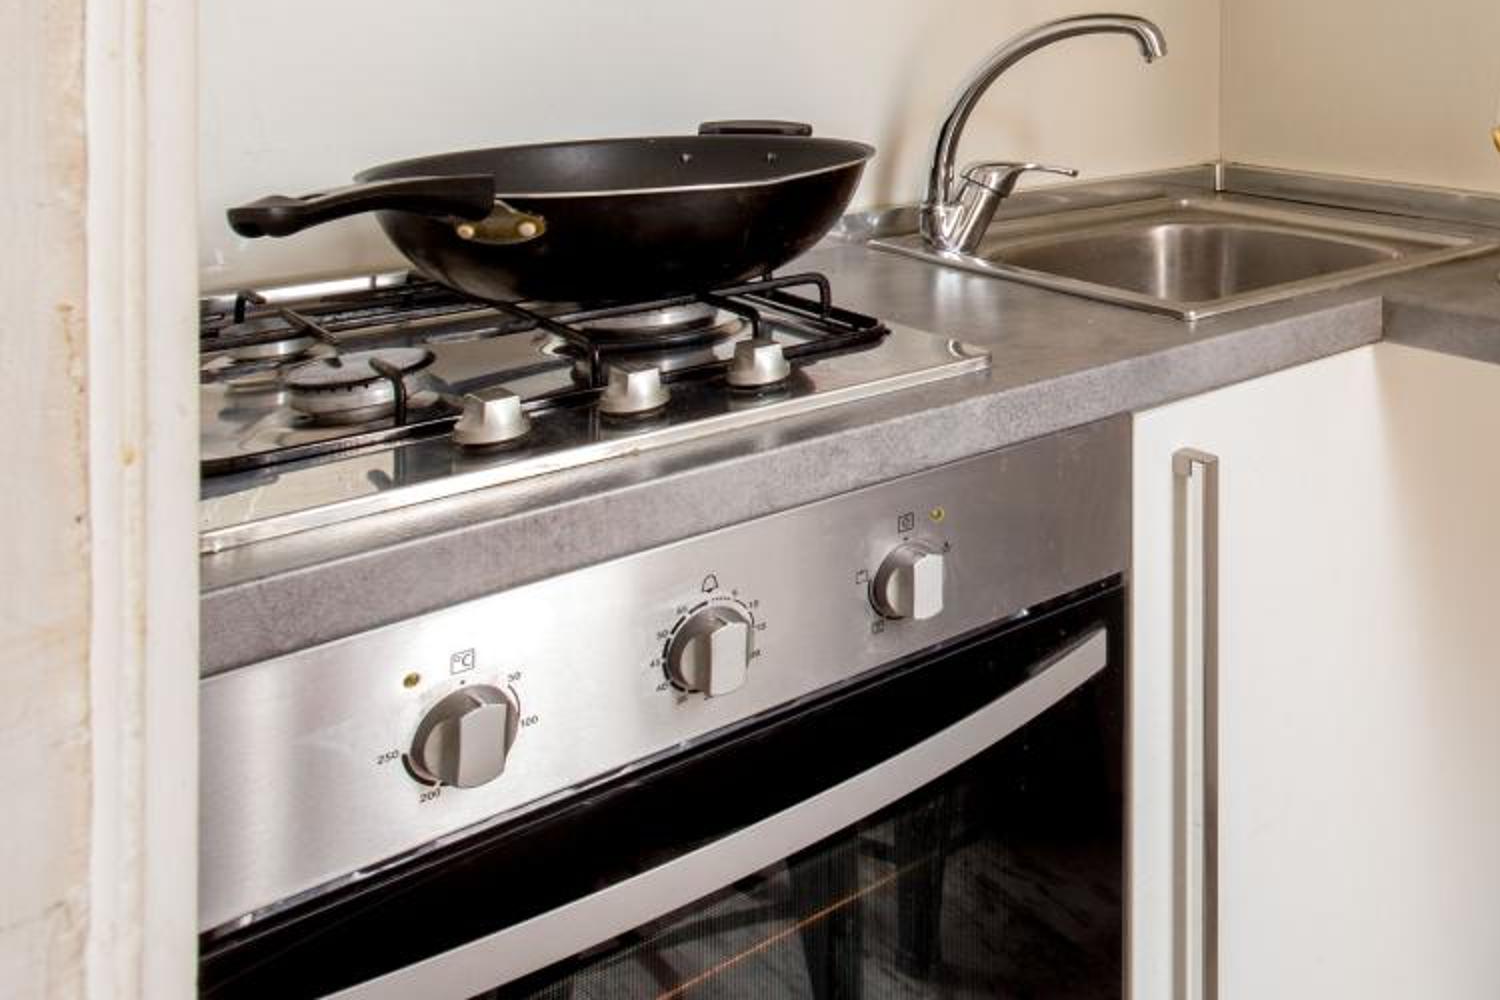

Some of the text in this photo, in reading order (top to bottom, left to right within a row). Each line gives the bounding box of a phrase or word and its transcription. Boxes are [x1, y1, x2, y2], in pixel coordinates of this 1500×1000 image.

[520, 715, 539, 727] 100
[377, 750, 399, 765] 250
[419, 788, 441, 804] 200
